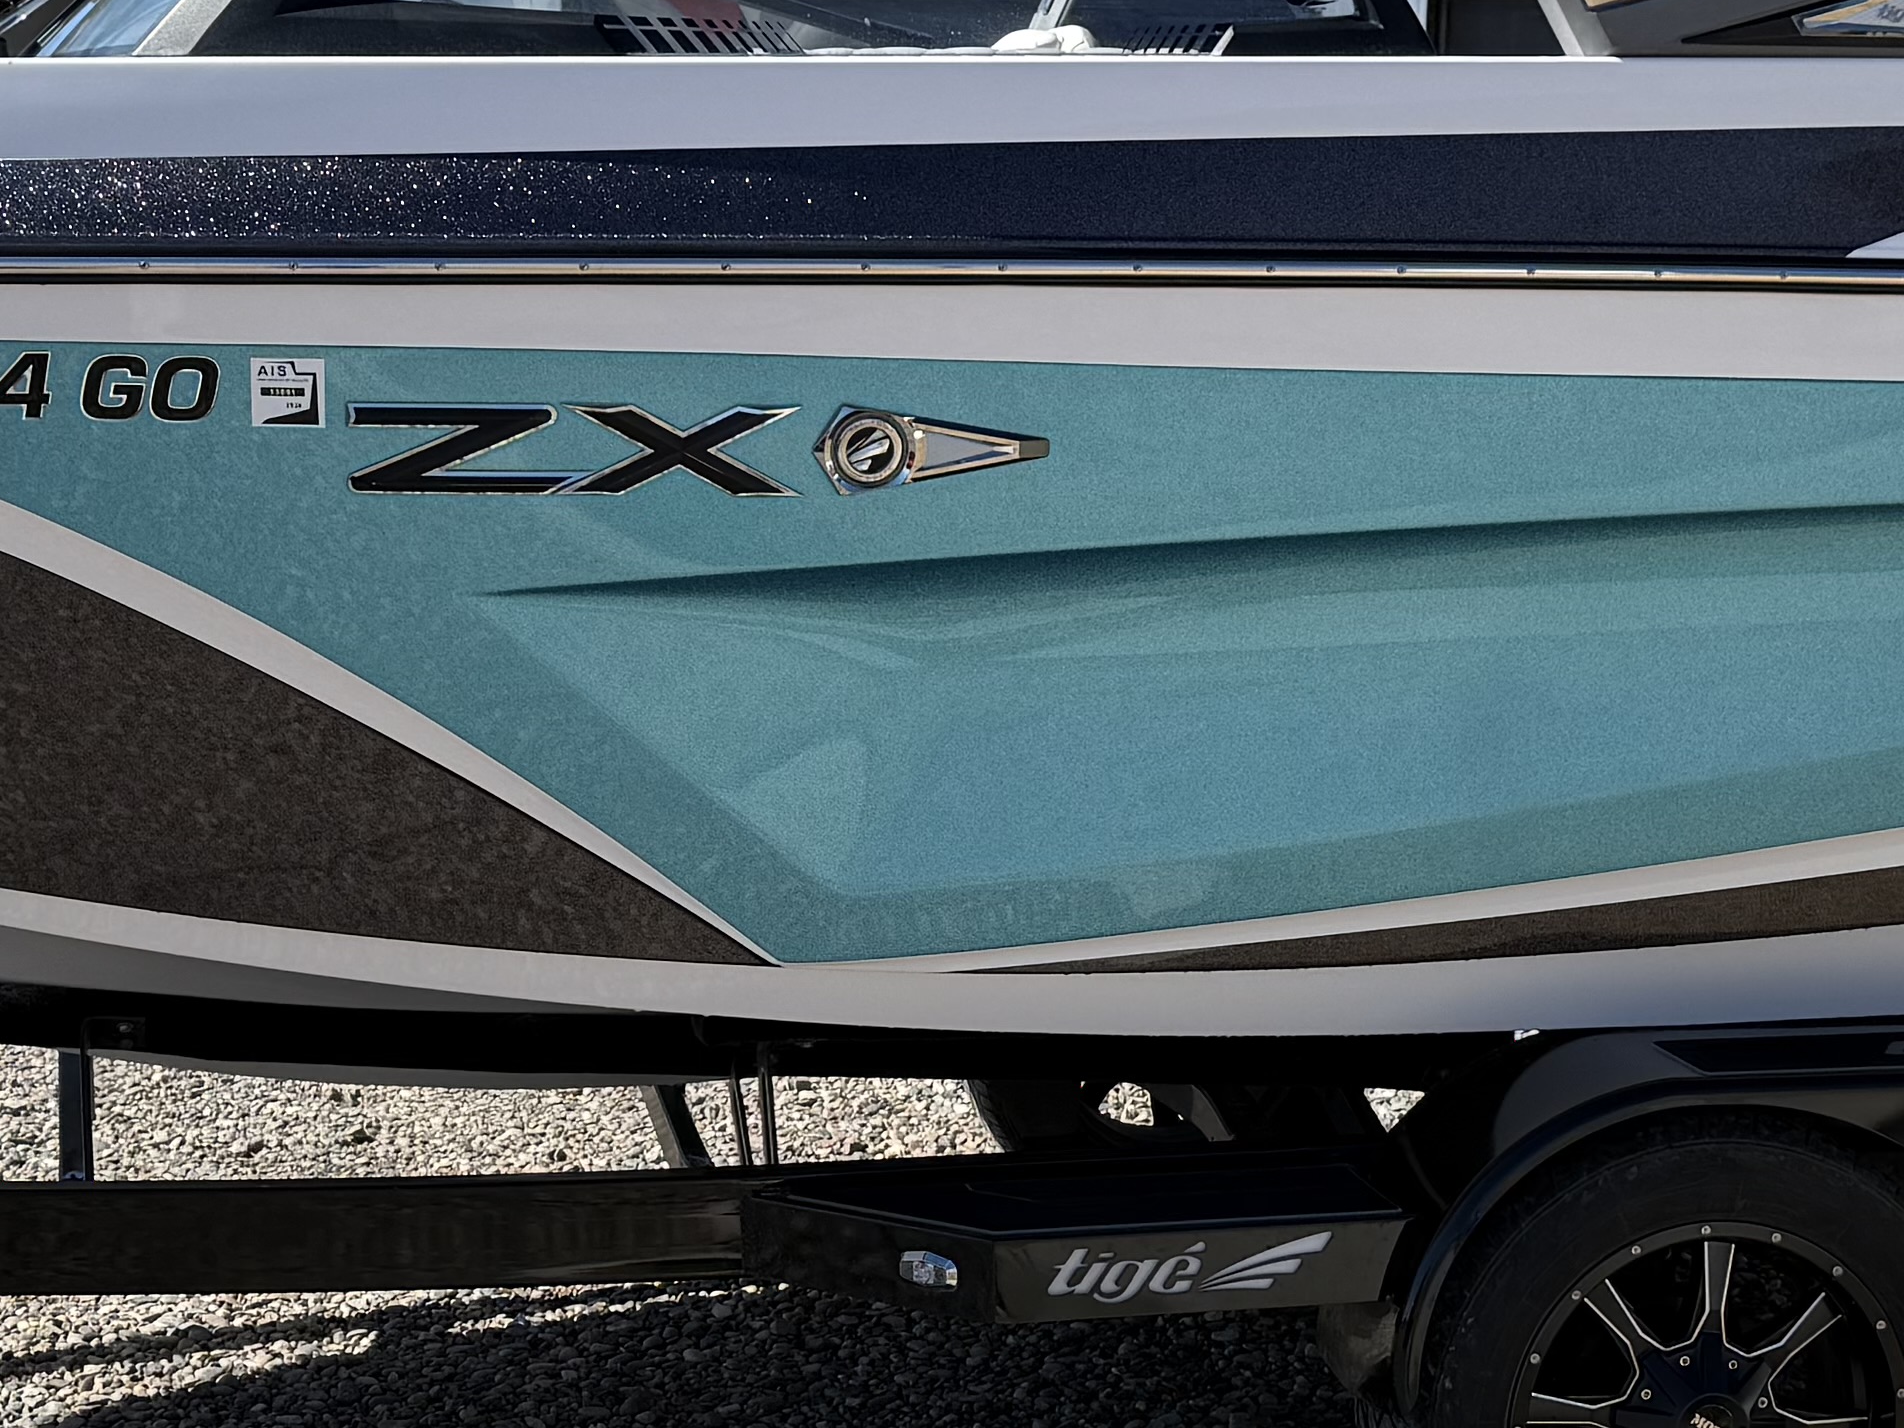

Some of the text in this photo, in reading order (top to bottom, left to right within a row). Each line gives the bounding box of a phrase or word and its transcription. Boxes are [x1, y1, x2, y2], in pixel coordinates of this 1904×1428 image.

[79, 353, 221, 422] GO
[257, 365, 287, 377] AIS
[346, 401, 803, 498] ZX
[1046, 1240, 1206, 1304] tigé
